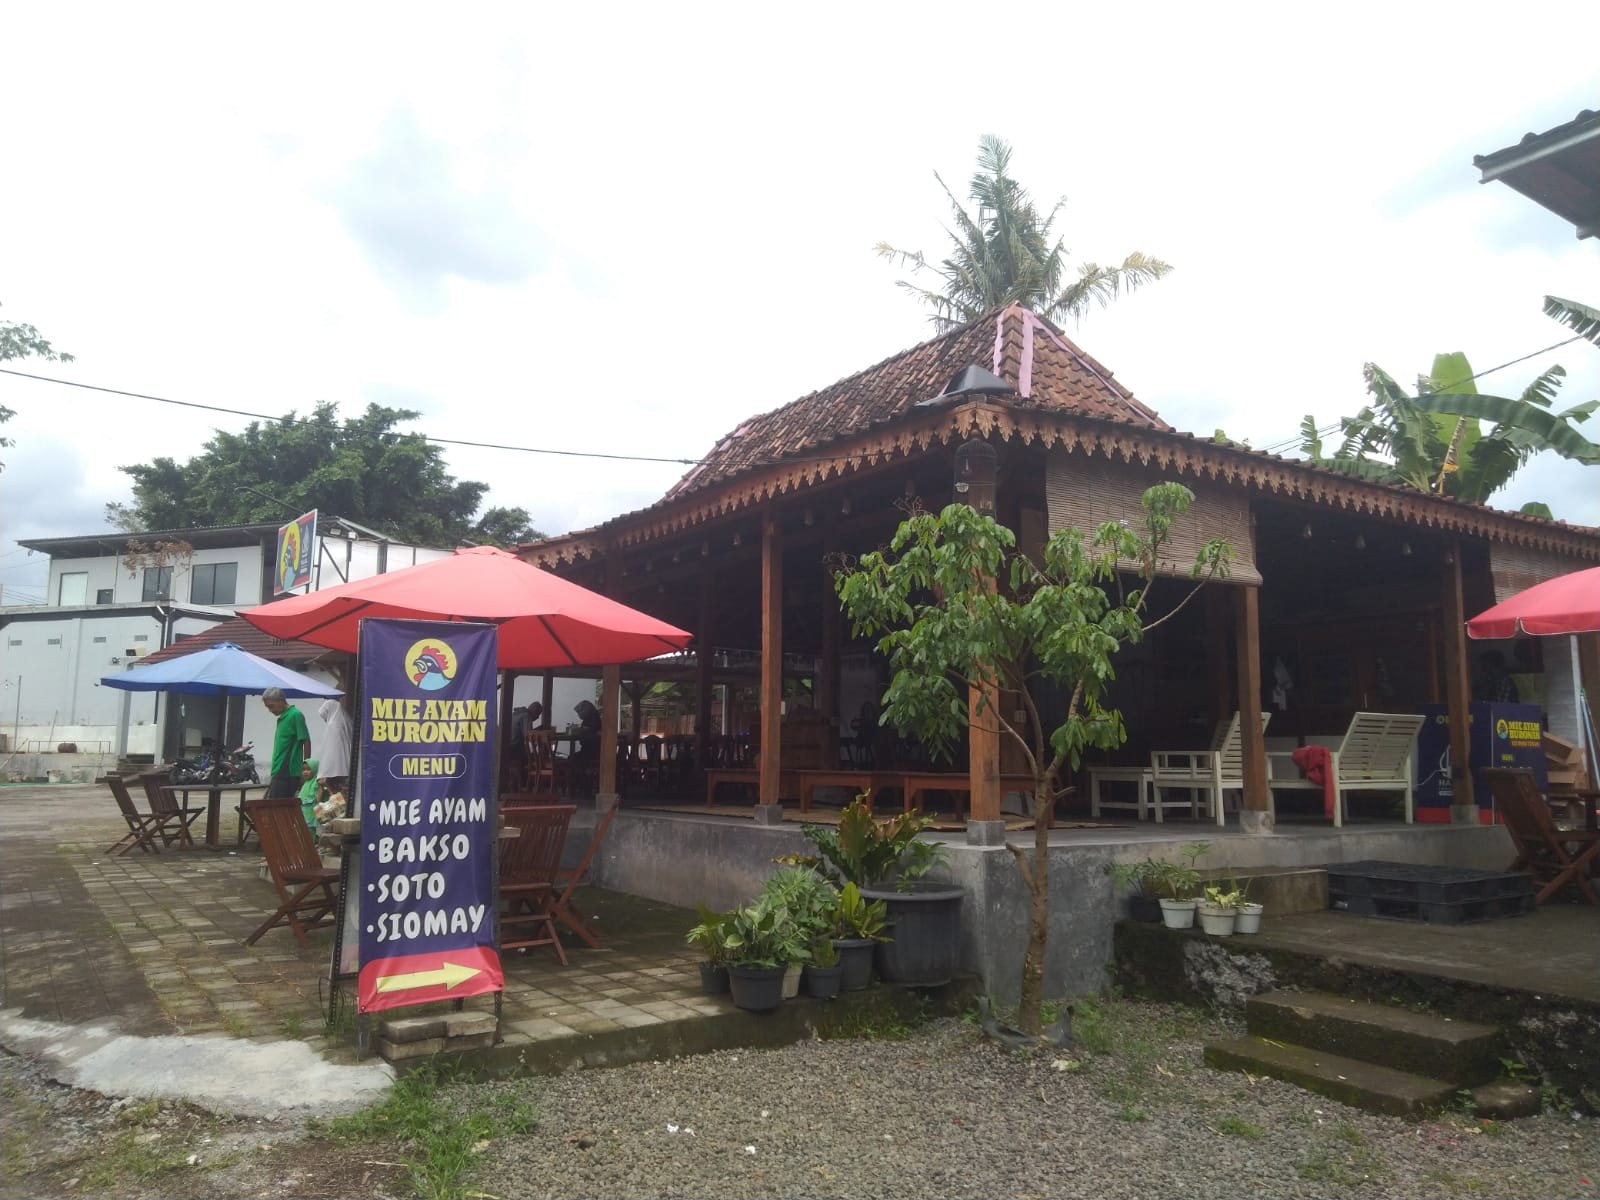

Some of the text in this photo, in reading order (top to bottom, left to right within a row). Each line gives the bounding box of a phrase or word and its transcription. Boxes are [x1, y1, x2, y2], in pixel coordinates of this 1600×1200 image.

[371, 698, 488, 721] MIE AYAM
[371, 720, 487, 743] BURONAN
[402, 757, 457, 776] MENU
[379, 797, 486, 826] MIE AYAM
[378, 833, 470, 864] BAKSO
[377, 871, 446, 903] SOTO
[376, 903, 485, 943] SIOMAY
